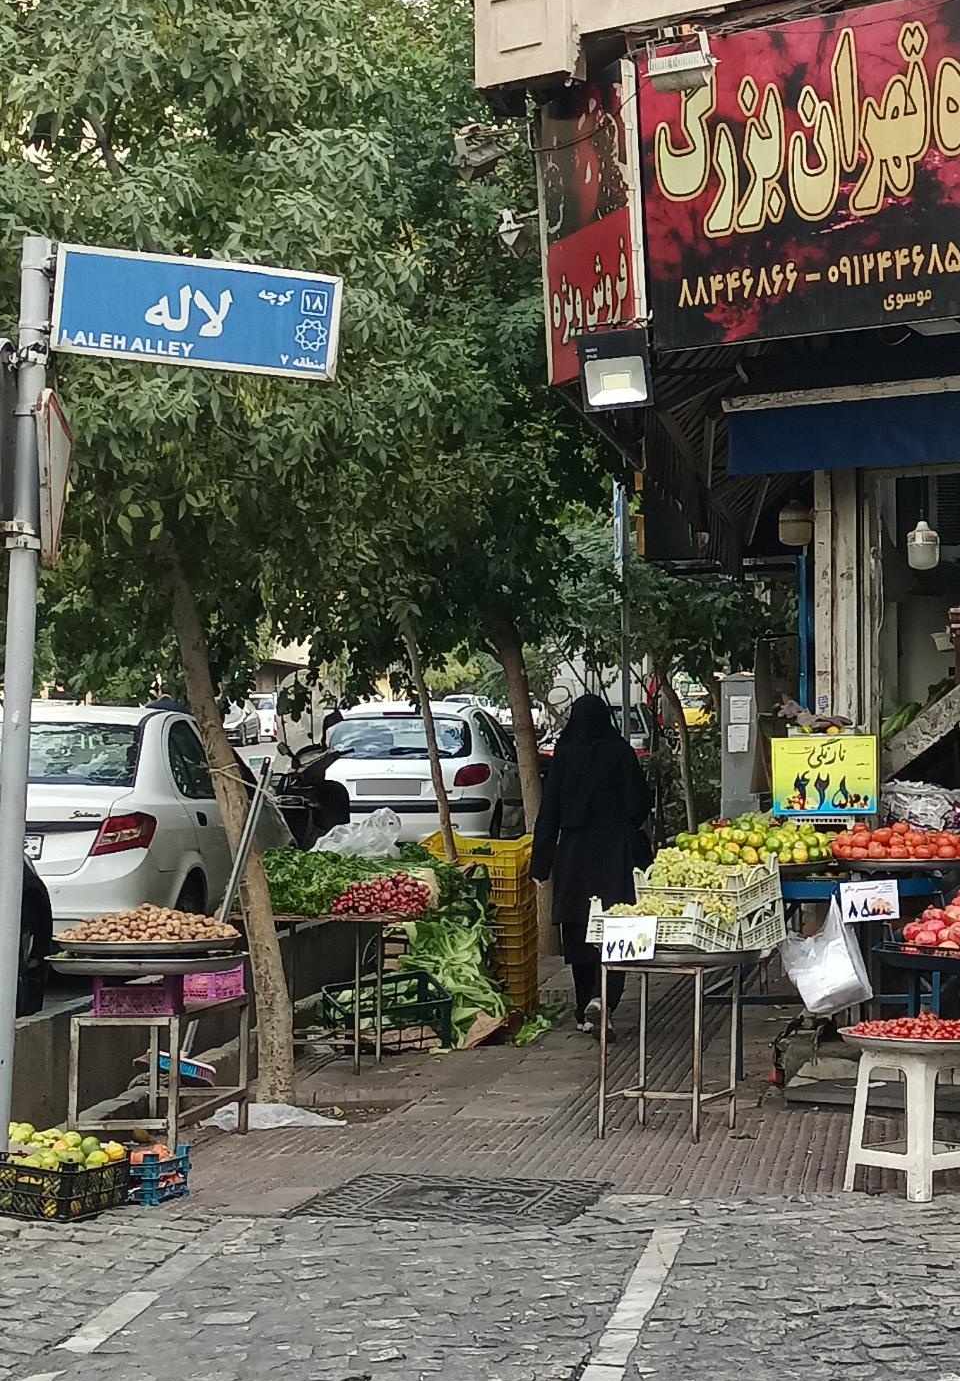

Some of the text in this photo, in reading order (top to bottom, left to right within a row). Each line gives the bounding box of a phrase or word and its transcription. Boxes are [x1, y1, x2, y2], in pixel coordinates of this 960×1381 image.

[789, 20, 931, 222] تهران
[258, 289, 295, 307] کوچه
[586, 236, 629, 333] فروش
[677, 260, 799, 309] ۸۸۴۴۶۸۶۶
[144, 284, 234, 338] لاله
[305, 293, 324, 312] ۱۸
[882, 287, 933, 312] موسوی
[129, 337, 195, 358] ALLEY
[280, 353, 326, 370] منطقه ۷
[807, 739, 847, 769] نارنگی
